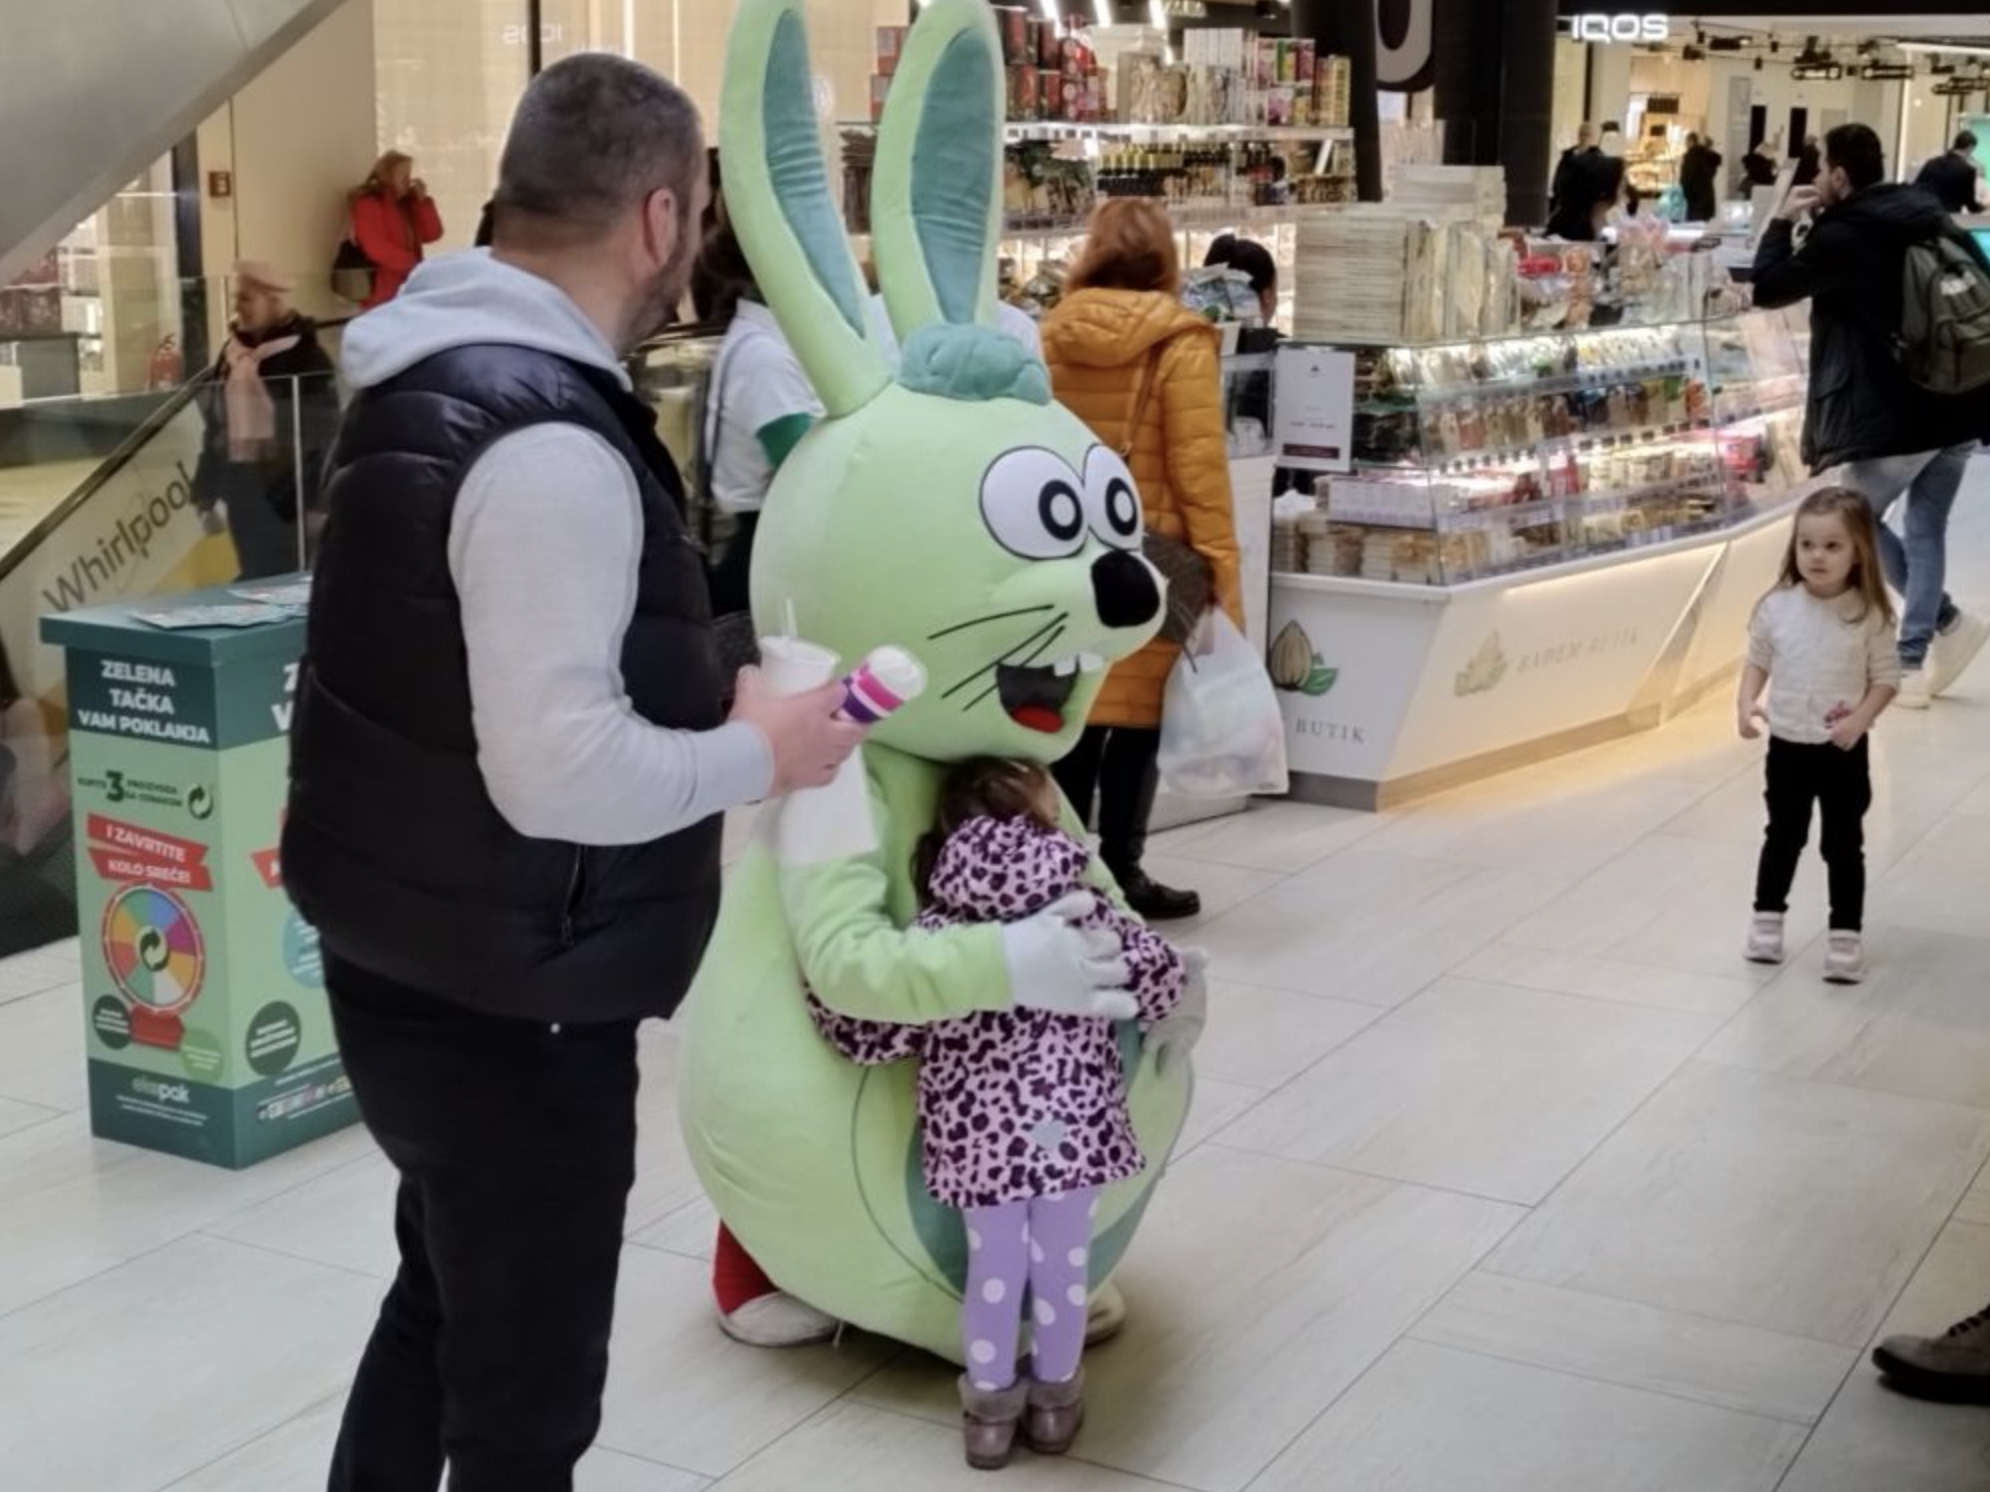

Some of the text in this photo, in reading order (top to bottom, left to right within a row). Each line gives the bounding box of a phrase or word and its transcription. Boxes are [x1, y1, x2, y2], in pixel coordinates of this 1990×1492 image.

[1572, 13, 1669, 44] IQOS
[42, 459, 192, 612] Whirlpool
[101, 659, 176, 687] ZELENA
[109, 687, 175, 715] TAČKA
[78, 709, 210, 743] VAM POKLANJA
[1295, 716, 1366, 745] BUTIK
[105, 769, 125, 803] 3
[105, 823, 187, 863] I ZAVRTITE
[107, 859, 143, 877] KOLO
